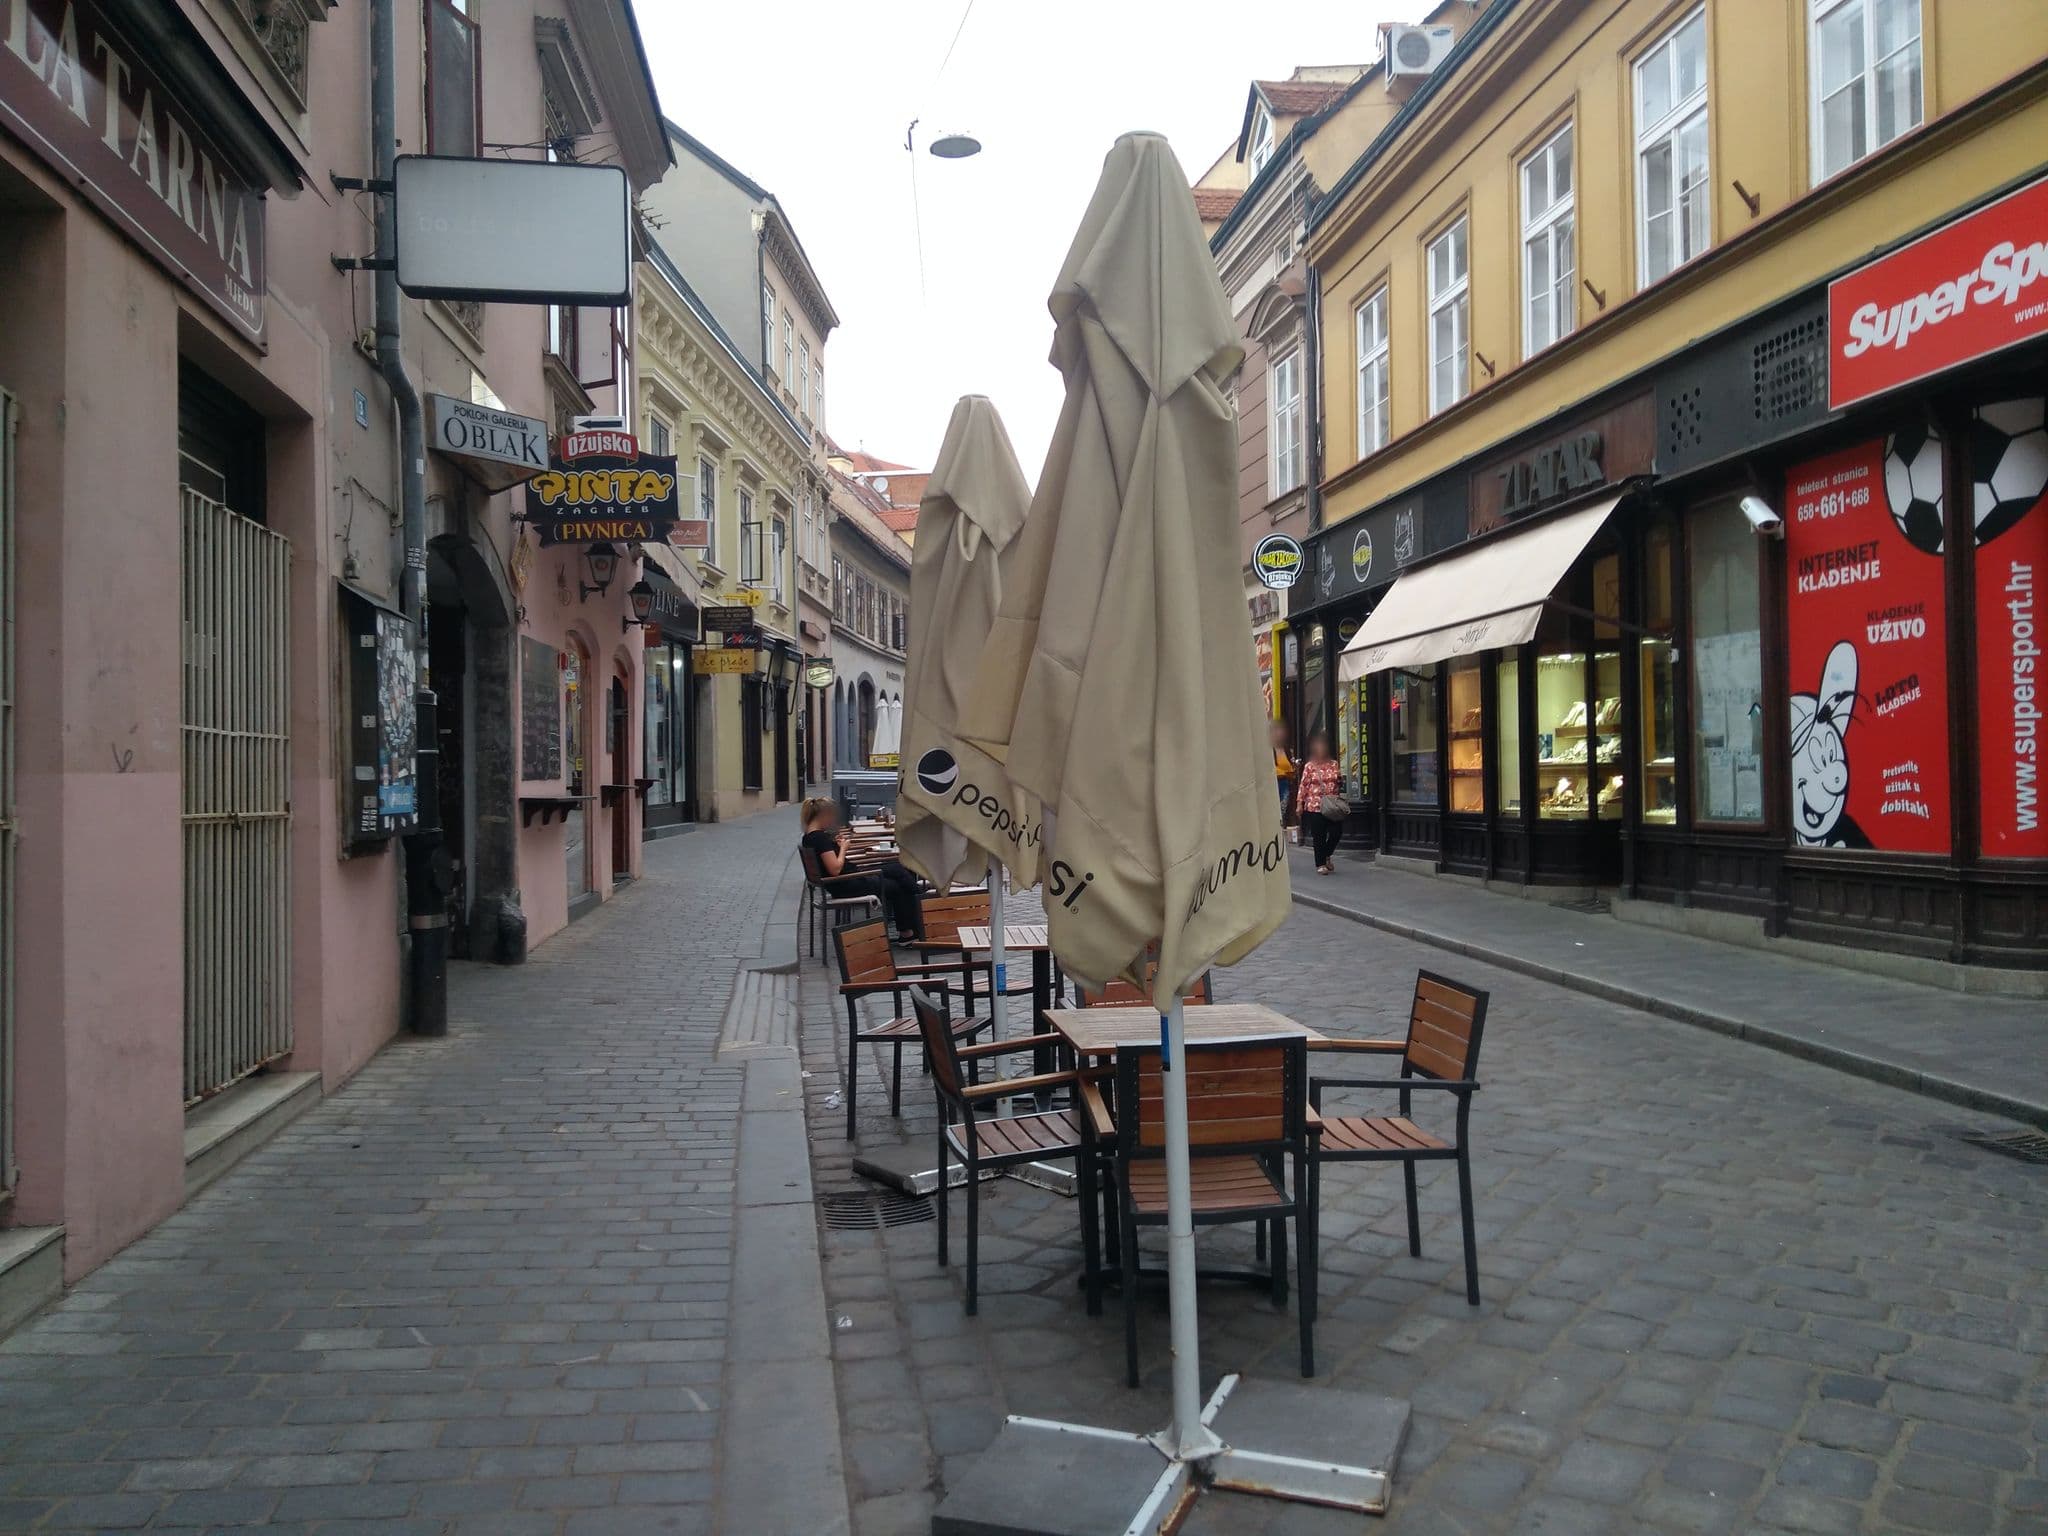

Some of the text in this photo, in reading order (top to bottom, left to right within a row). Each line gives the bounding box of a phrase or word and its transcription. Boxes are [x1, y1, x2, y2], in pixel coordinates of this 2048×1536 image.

[4, 0, 253, 288] LATARNA
[454, 405, 529, 432] POKLON GALERIJA
[443, 416, 545, 466] OBLAK
[568, 433, 632, 457] Ožujsko
[530, 469, 674, 505] PINTA
[1797, 466, 1869, 496] teletext stranica
[556, 505, 649, 515] ZAGREB
[1798, 541, 1880, 576] INTERNET
[1866, 618, 1926, 645] UŽIVO
[2005, 561, 2042, 832] www.supersport.hr
[1885, 778, 1921, 794] užitak u
[1880, 801, 1931, 820] dobitak!
